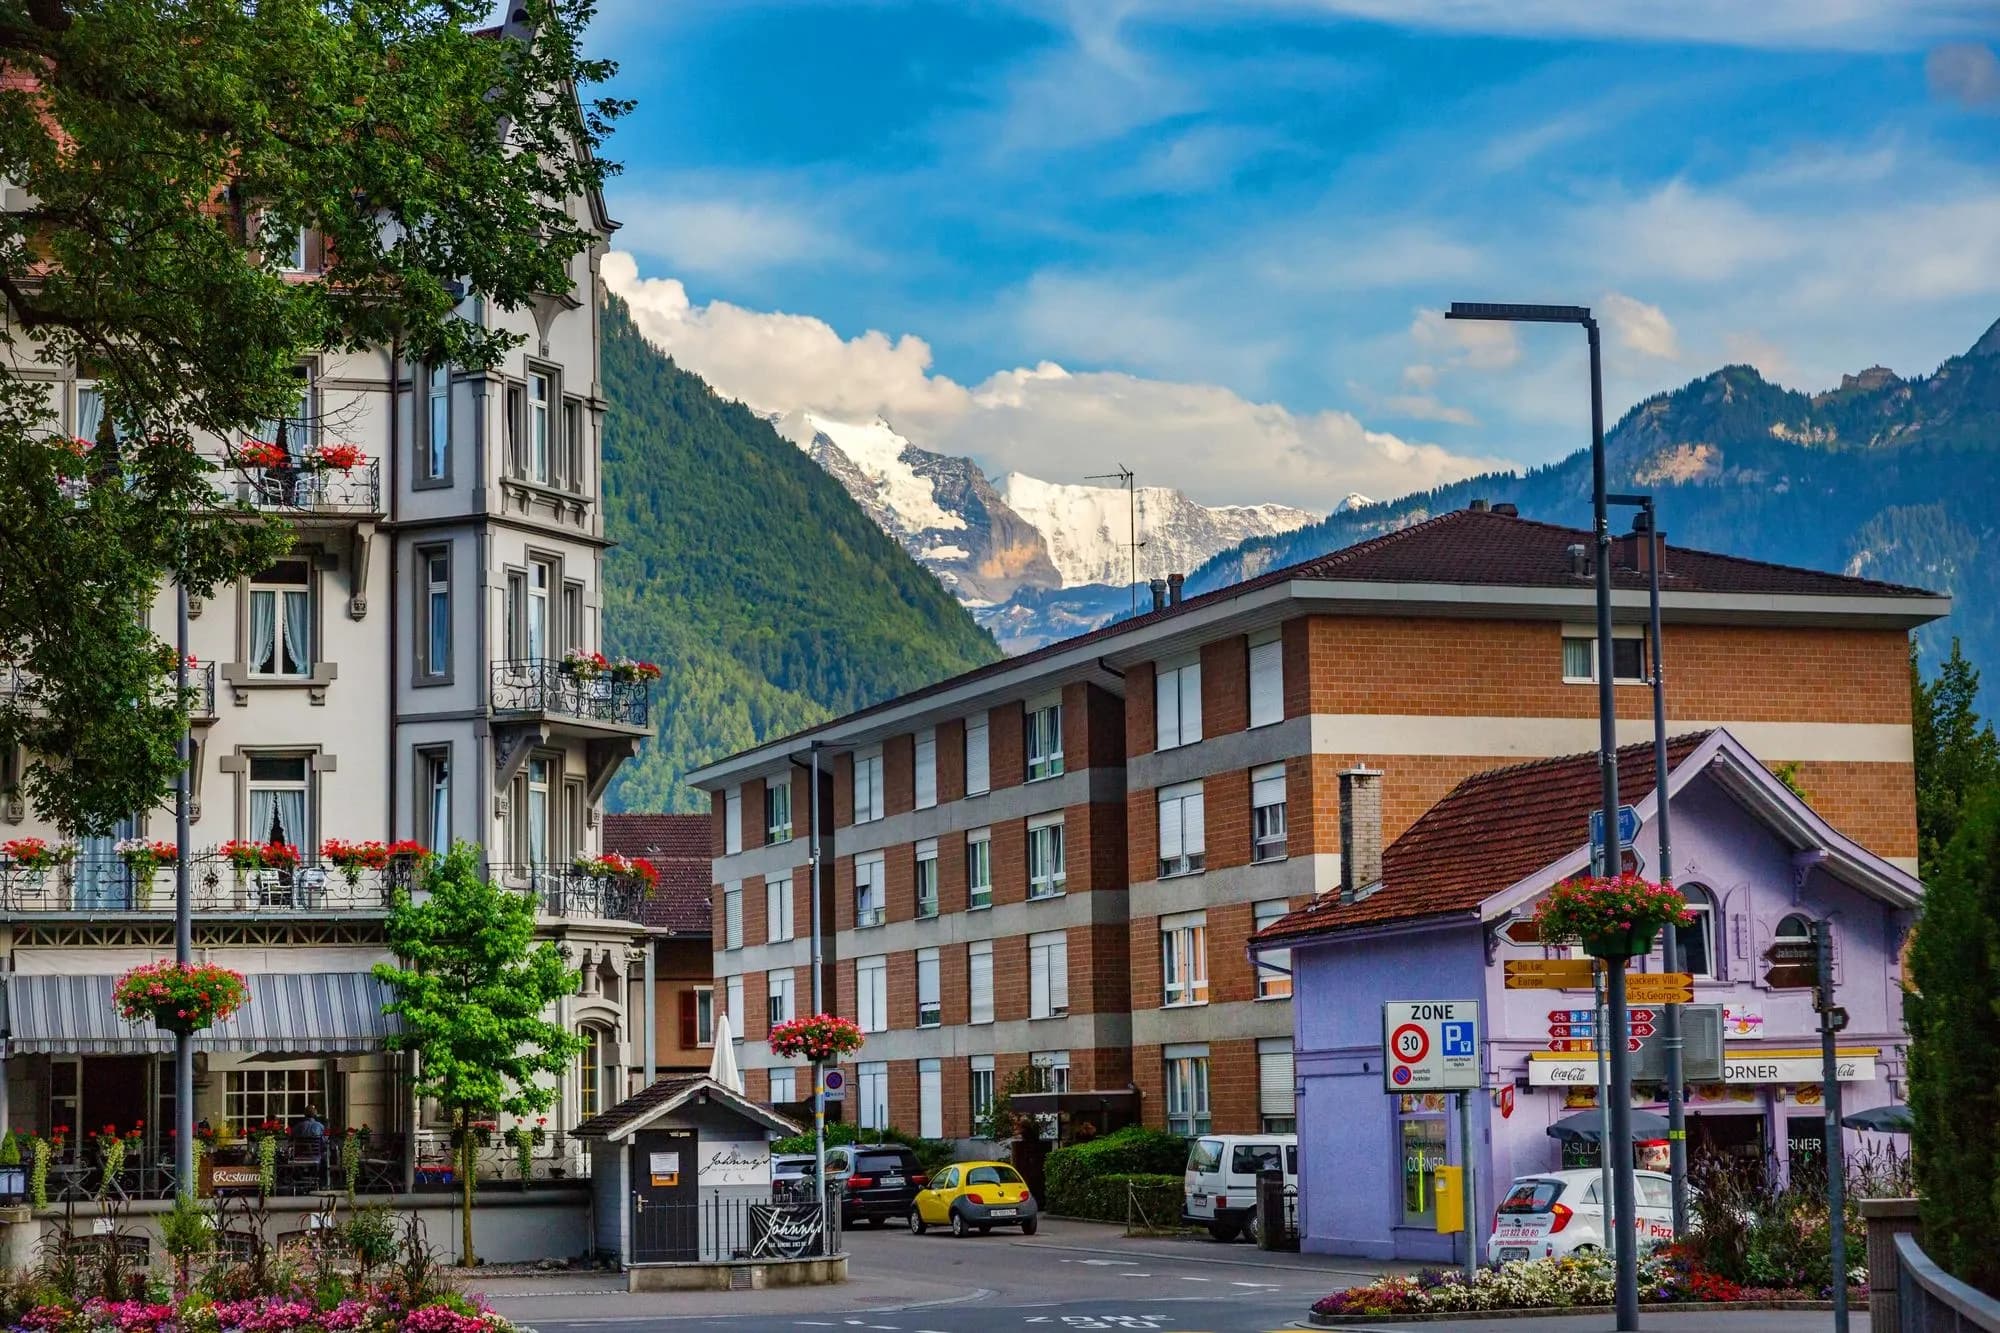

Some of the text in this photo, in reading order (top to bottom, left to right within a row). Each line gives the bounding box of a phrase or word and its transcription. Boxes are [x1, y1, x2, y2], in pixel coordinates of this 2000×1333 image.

[1663, 974, 1679, 985] Villa
[1411, 1005, 1454, 1020] ZONE
[1402, 1036, 1419, 1051] 30
[1445, 1025, 1461, 1051] P
[1651, 1225, 1672, 1238] Pizz
